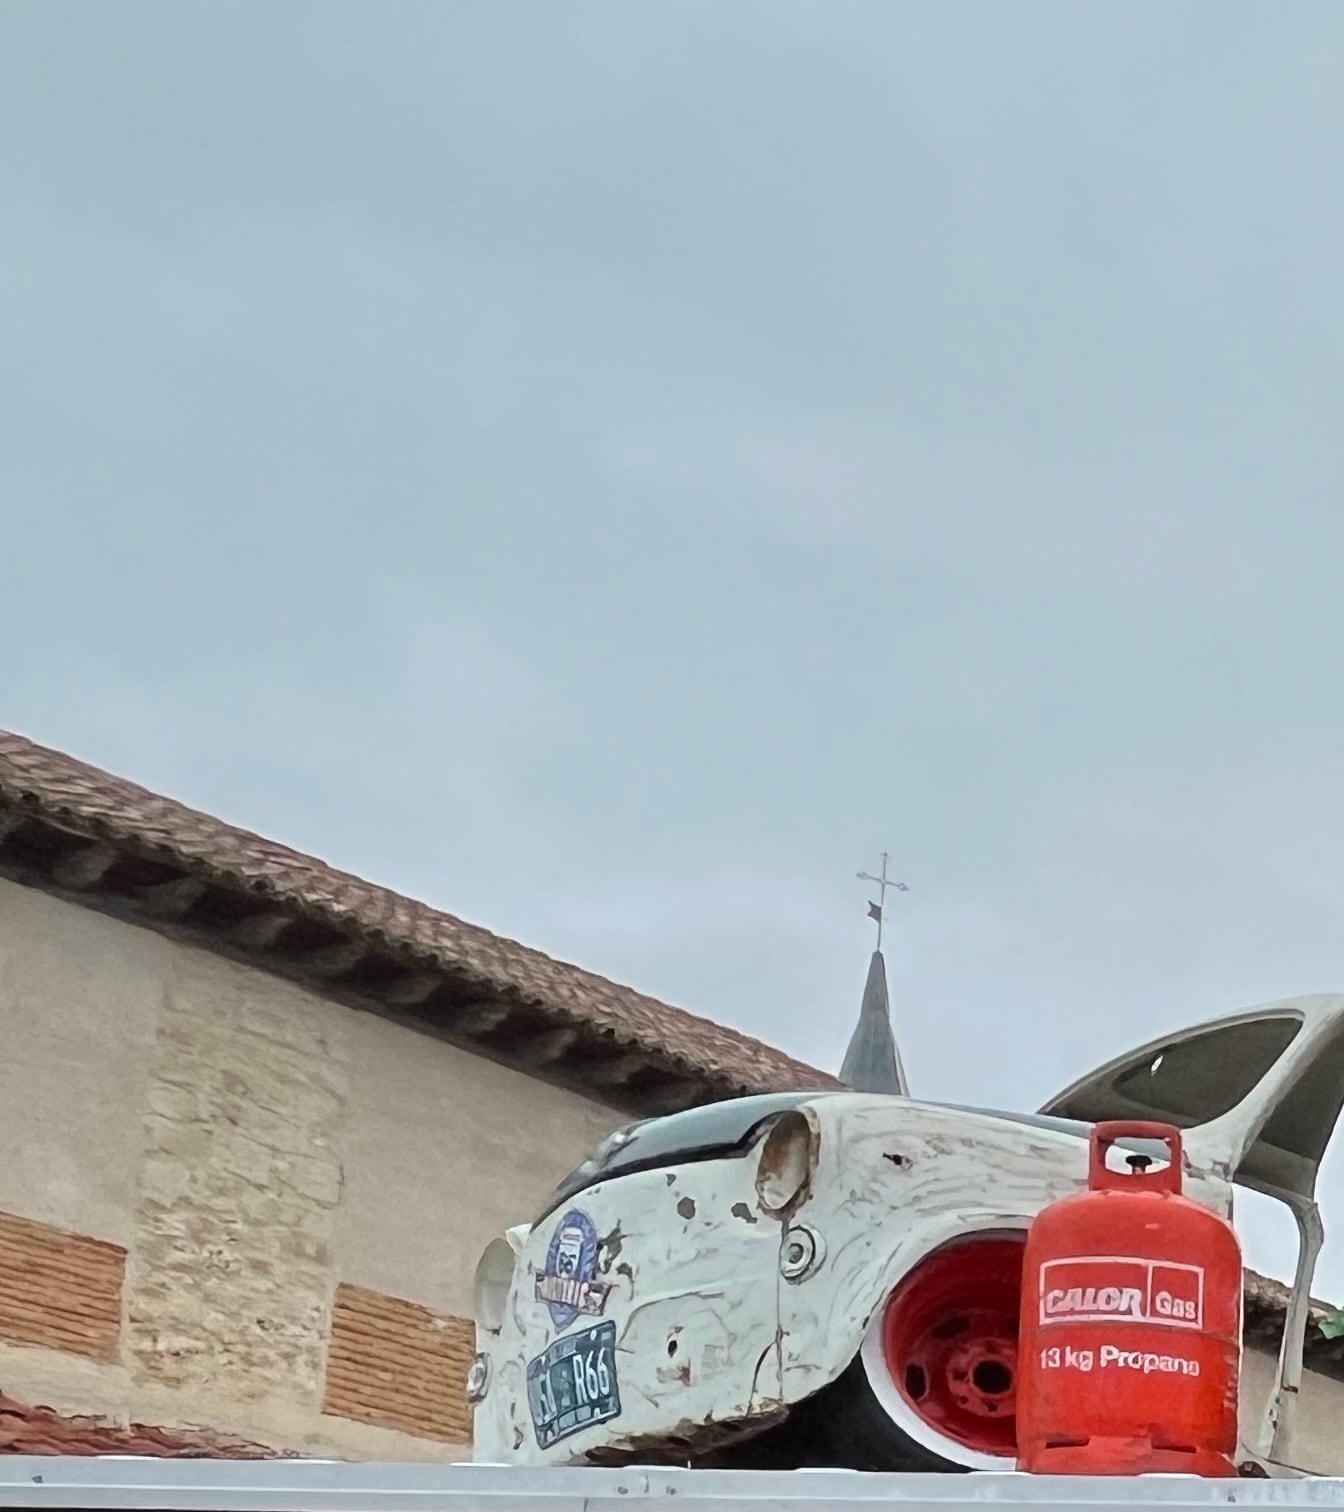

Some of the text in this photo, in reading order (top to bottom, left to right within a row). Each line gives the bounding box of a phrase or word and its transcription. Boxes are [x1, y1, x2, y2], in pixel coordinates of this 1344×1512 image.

[1046, 1287, 1196, 1319] CALOR Gas
[1040, 1347, 1061, 1370] 13
[1064, 1345, 1094, 1372] kg
